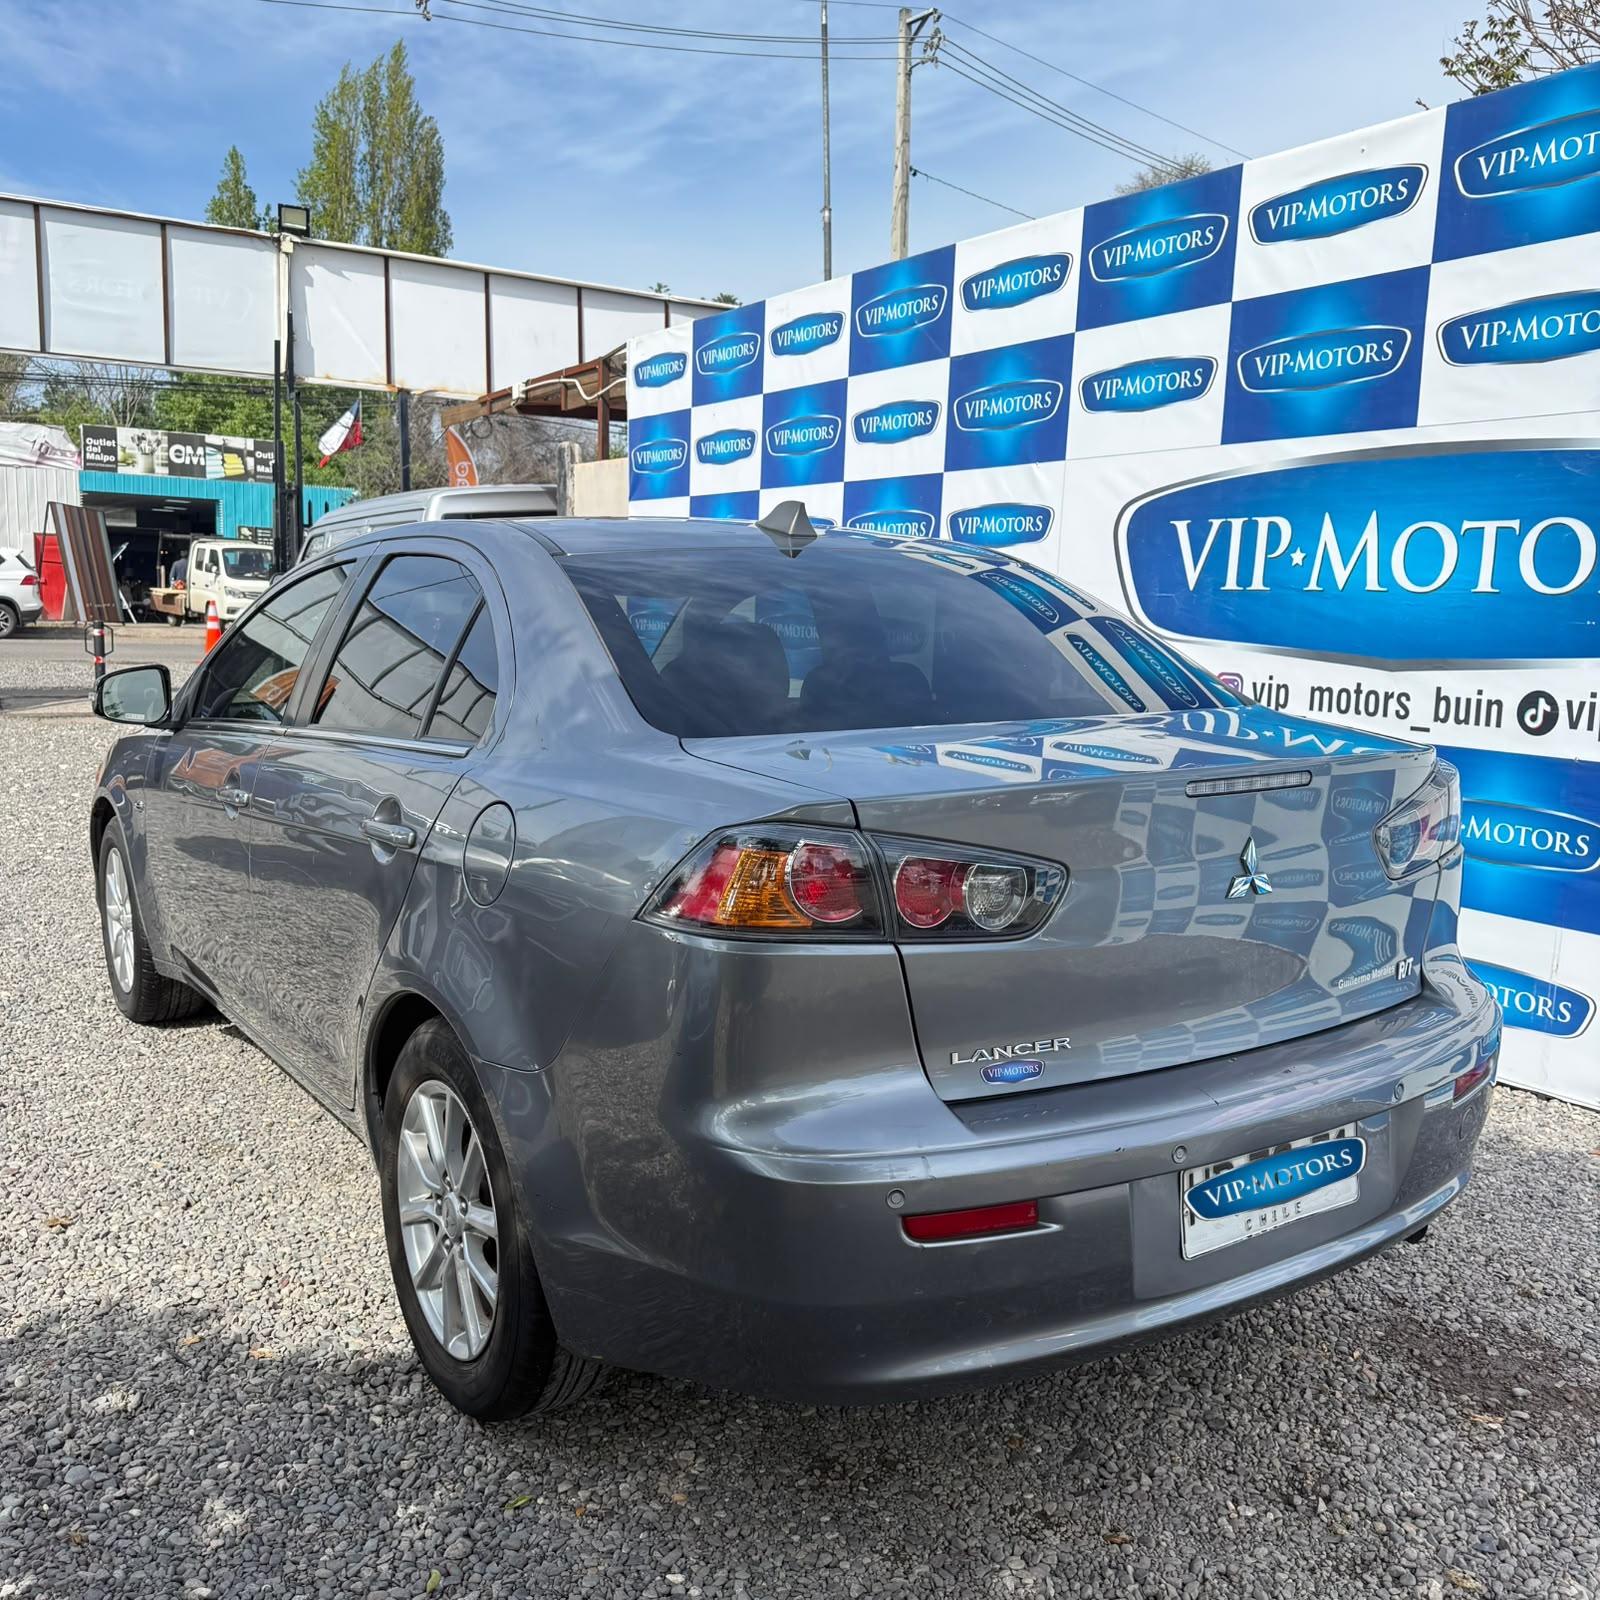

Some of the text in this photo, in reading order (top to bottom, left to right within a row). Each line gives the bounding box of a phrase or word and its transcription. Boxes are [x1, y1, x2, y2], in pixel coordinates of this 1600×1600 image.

[86, 437, 116, 448] Outlet
[86, 445, 101, 453] del
[86, 452, 116, 463] Maipo
[1566, 691, 1600, 742] vi
[1338, 972, 1371, 990] Guillermo
[1371, 964, 1396, 980] Morales
[950, 1037, 1071, 1065] LANCER
[1244, 1201, 1302, 1231] CHILE
